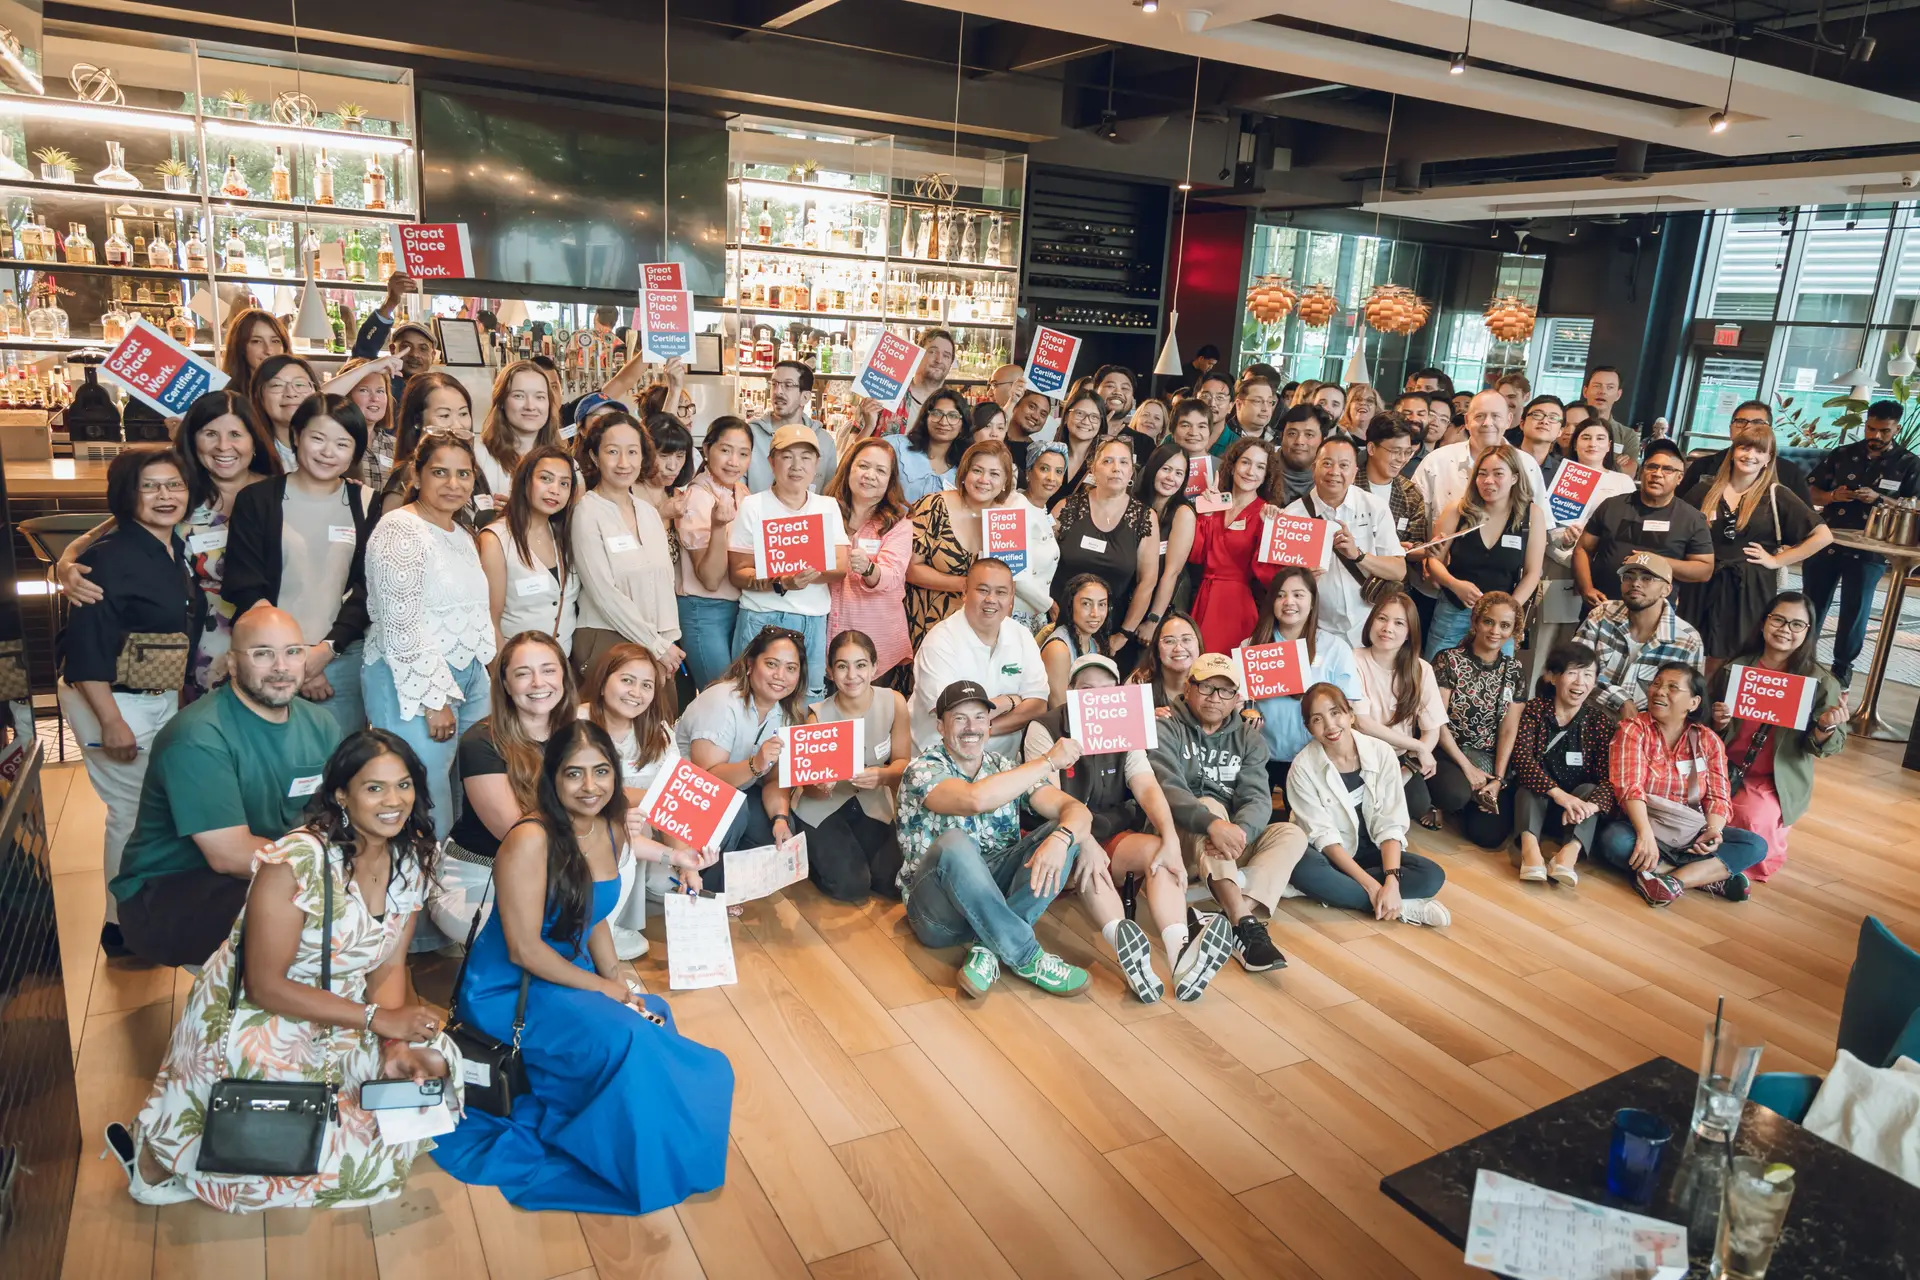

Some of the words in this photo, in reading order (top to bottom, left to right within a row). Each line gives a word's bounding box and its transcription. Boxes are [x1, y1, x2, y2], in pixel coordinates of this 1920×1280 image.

[403, 228, 444, 238] Great
[406, 240, 445, 251] Place
[407, 253, 423, 263] To
[648, 293, 677, 302] Great
[649, 302, 677, 311] Place
[649, 311, 660, 320] To
[884, 335, 910, 353] Great
[1043, 332, 1067, 345] Great
[880, 343, 905, 360] Place
[1039, 347, 1047, 356] To
[1041, 340, 1063, 353] Place
[110, 338, 142, 371] Great
[877, 350, 886, 361] To
[121, 348, 152, 379] Place
[132, 372, 149, 386] To
[868, 371, 897, 390] Certified
[1034, 368, 1061, 380] Certified
[164, 366, 197, 403] Certified
[1567, 465, 1592, 478] Great
[1561, 479, 1570, 487] To
[1564, 472, 1587, 485] Place
[1553, 498, 1581, 511] Certified
[990, 512, 1016, 521] Great
[766, 520, 808, 534] Great
[991, 522, 1016, 530] Place
[1277, 517, 1313, 531] Great
[769, 534, 809, 547] Place
[1276, 528, 1311, 542] Place
[1274, 539, 1287, 550] To
[768, 549, 785, 560] To
[1245, 646, 1284, 660] Great
[1248, 659, 1285, 672] Place
[1248, 674, 1264, 684] To
[1745, 670, 1788, 687] Great
[1743, 681, 1784, 698] Place
[1083, 691, 1126, 705] Great
[1741, 693, 1756, 705] To
[1085, 707, 1127, 720] Place
[794, 727, 838, 741] Great
[1085, 722, 1102, 735] To
[795, 742, 838, 755] Place
[794, 757, 811, 768] To
[678, 765, 720, 797] Great
[669, 778, 710, 810] Place
[662, 792, 678, 811] To
